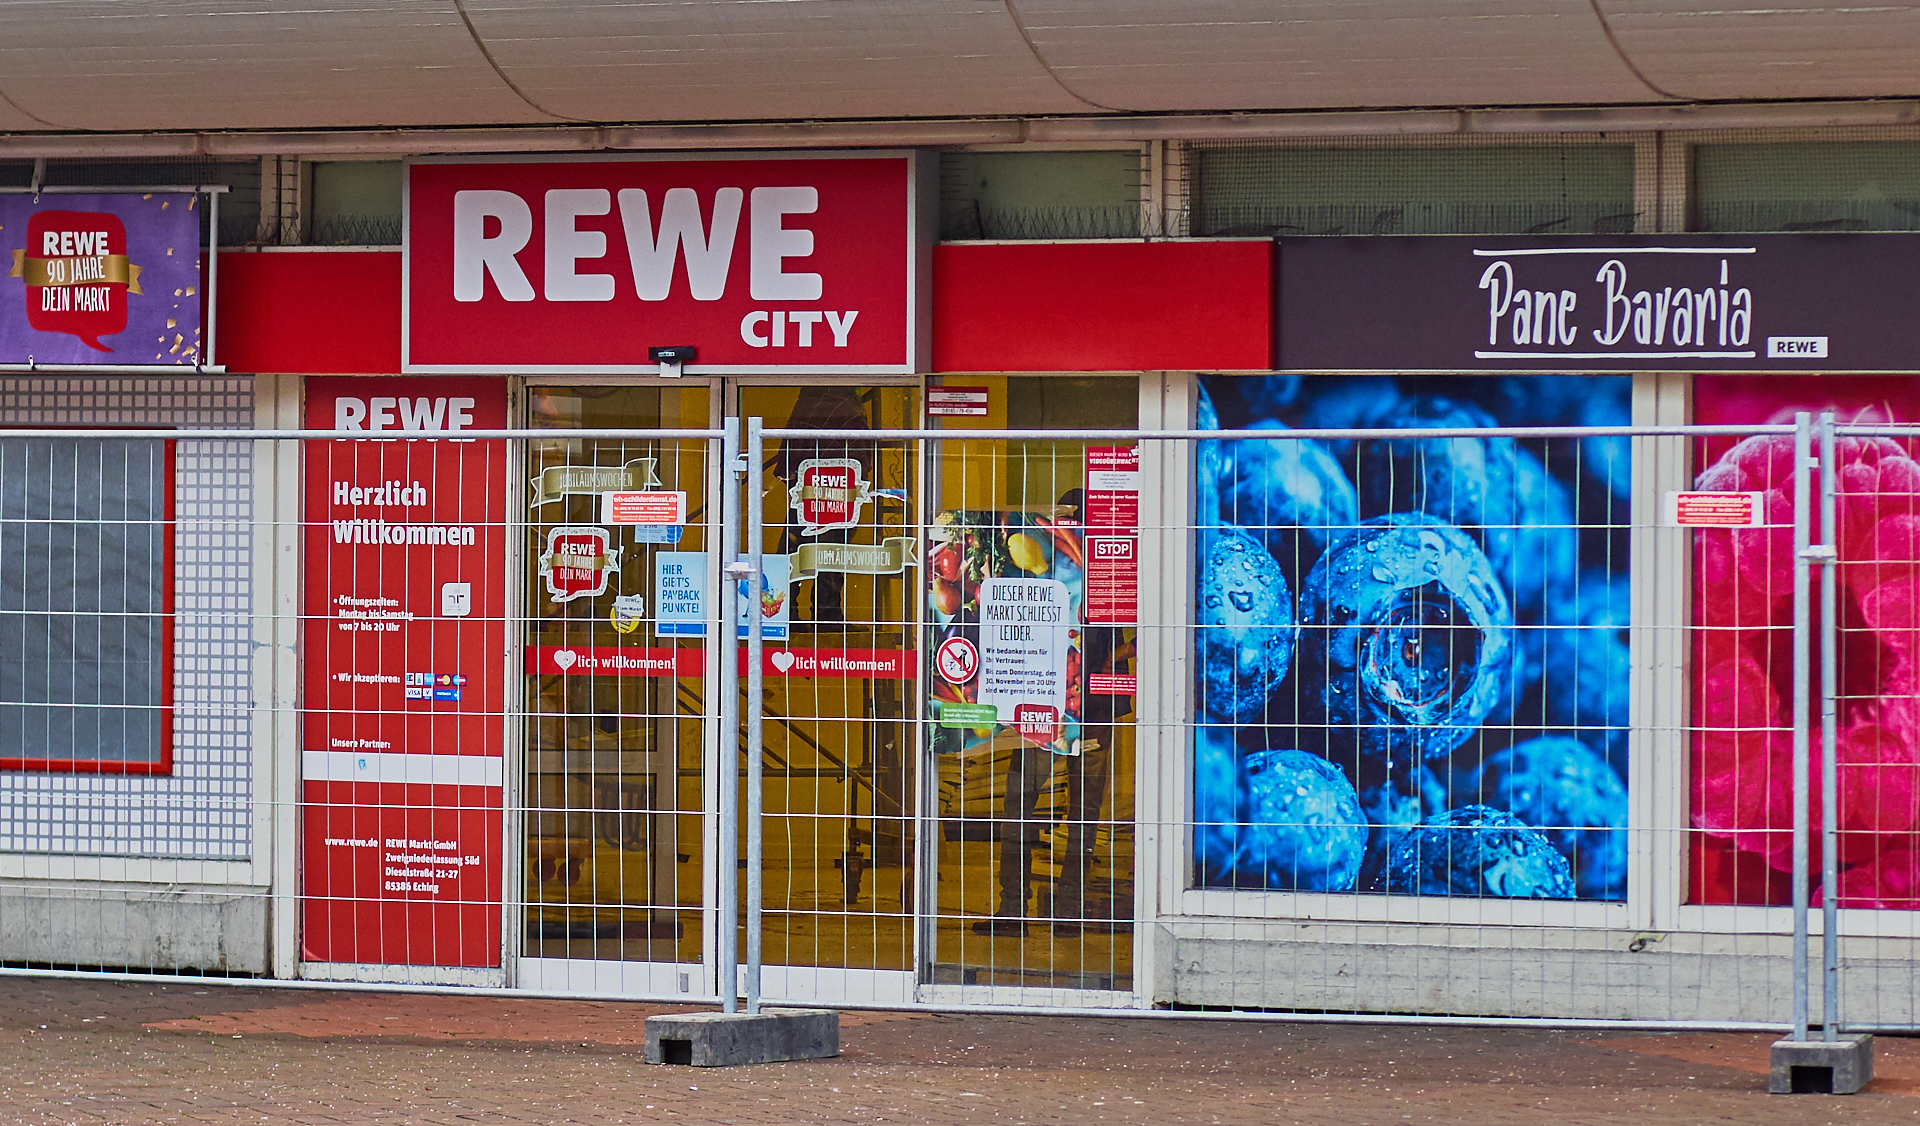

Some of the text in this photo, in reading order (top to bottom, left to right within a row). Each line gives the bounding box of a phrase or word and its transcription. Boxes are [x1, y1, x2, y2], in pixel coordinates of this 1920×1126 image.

[43, 231, 109, 256] REWE
[453, 186, 823, 302] REWE
[47, 256, 106, 284] 90 JAHRE
[42, 286, 111, 312] DEIN MARKT
[1478, 259, 1752, 347] Pane Bavaria
[740, 310, 859, 348] CITY
[1777, 341, 1818, 353] REWE
[335, 397, 476, 442] REWE
[559, 471, 633, 489] JUBILÄUMSWOCHEN
[811, 475, 847, 487] REWE
[333, 480, 427, 506] Herzlich
[825, 488, 845, 500] JAHRE
[811, 501, 825, 512] DIN
[332, 518, 475, 545] Willkommen
[561, 543, 596, 556] REWE
[1097, 543, 1129, 555] STOP
[816, 548, 891, 567] UBILÄUMSWOCHEN
[575, 568, 594, 581] MARK
[662, 564, 683, 575] HIER
[662, 590, 700, 600] PAYBACK
[992, 585, 1054, 602] DIESER REWE
[338, 594, 399, 608] Öffnungszeiten:
[662, 603, 699, 613] PUNKTE!
[986, 604, 1062, 622] MARKT SCHLIESST
[338, 609, 414, 621] Montag bis Samstag
[338, 622, 400, 631] von 7 bis 20 Uhr
[999, 625, 1034, 642] LEIDER.
[577, 655, 676, 669] lich willkommen!
[795, 656, 896, 671] lich willkommen!
[337, 672, 401, 684] Wir akzeptieren:
[1020, 711, 1053, 722] REWE
[331, 738, 391, 749] Unsere Partner:
[325, 838, 379, 847] www.rewe.de
[385, 839, 457, 850] REWE Markt GmbH
[385, 853, 480, 866] Zweigniederlassung Süd
[385, 867, 458, 879] Dieselstraße 21-27
[385, 881, 439, 894] 85386 Eching
